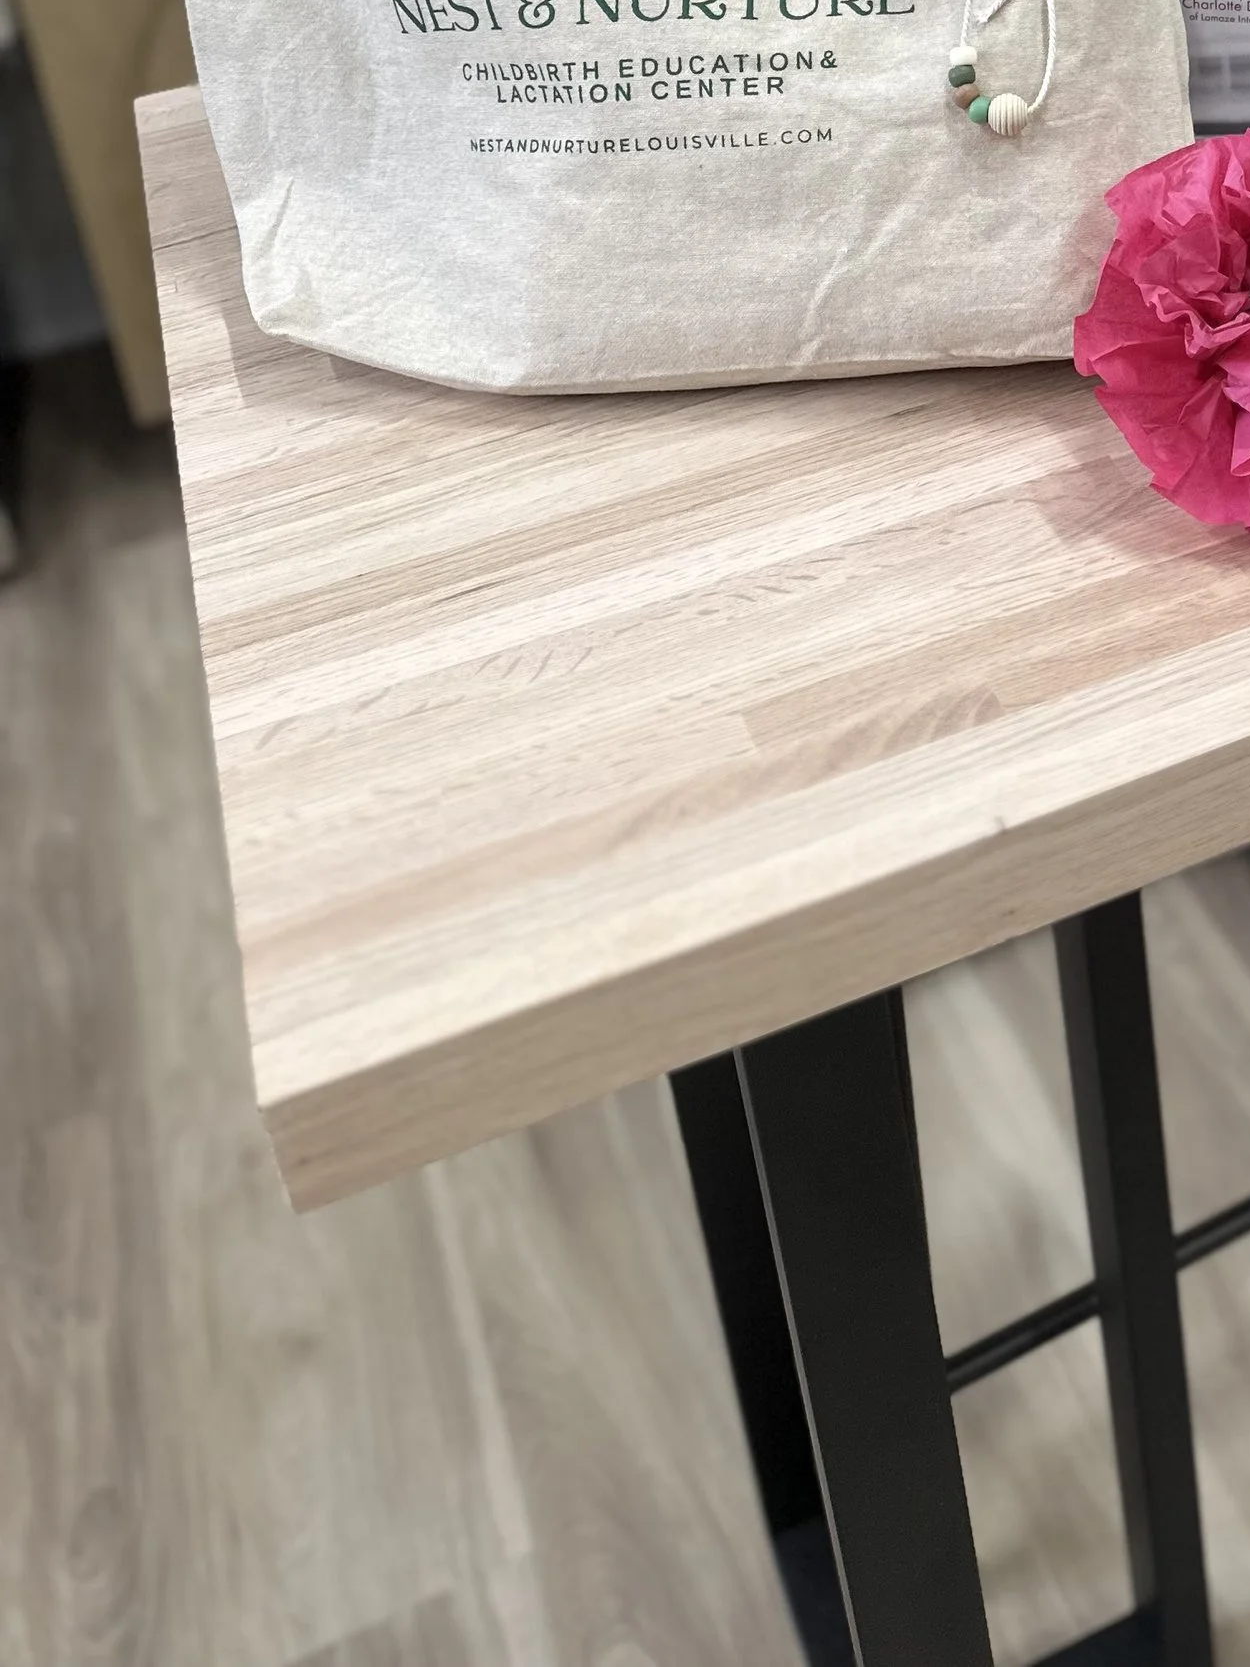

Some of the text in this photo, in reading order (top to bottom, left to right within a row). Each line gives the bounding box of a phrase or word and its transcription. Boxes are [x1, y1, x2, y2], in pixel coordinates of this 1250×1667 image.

[1189, 12, 1198, 21] of
[1201, 13, 1236, 23] Lamaze
[462, 60, 600, 83] CHILDBIRTH
[496, 77, 786, 104] LACTATION CENTER
[469, 128, 833, 154] NESTANDNURTURELOUISVILLE.COM
